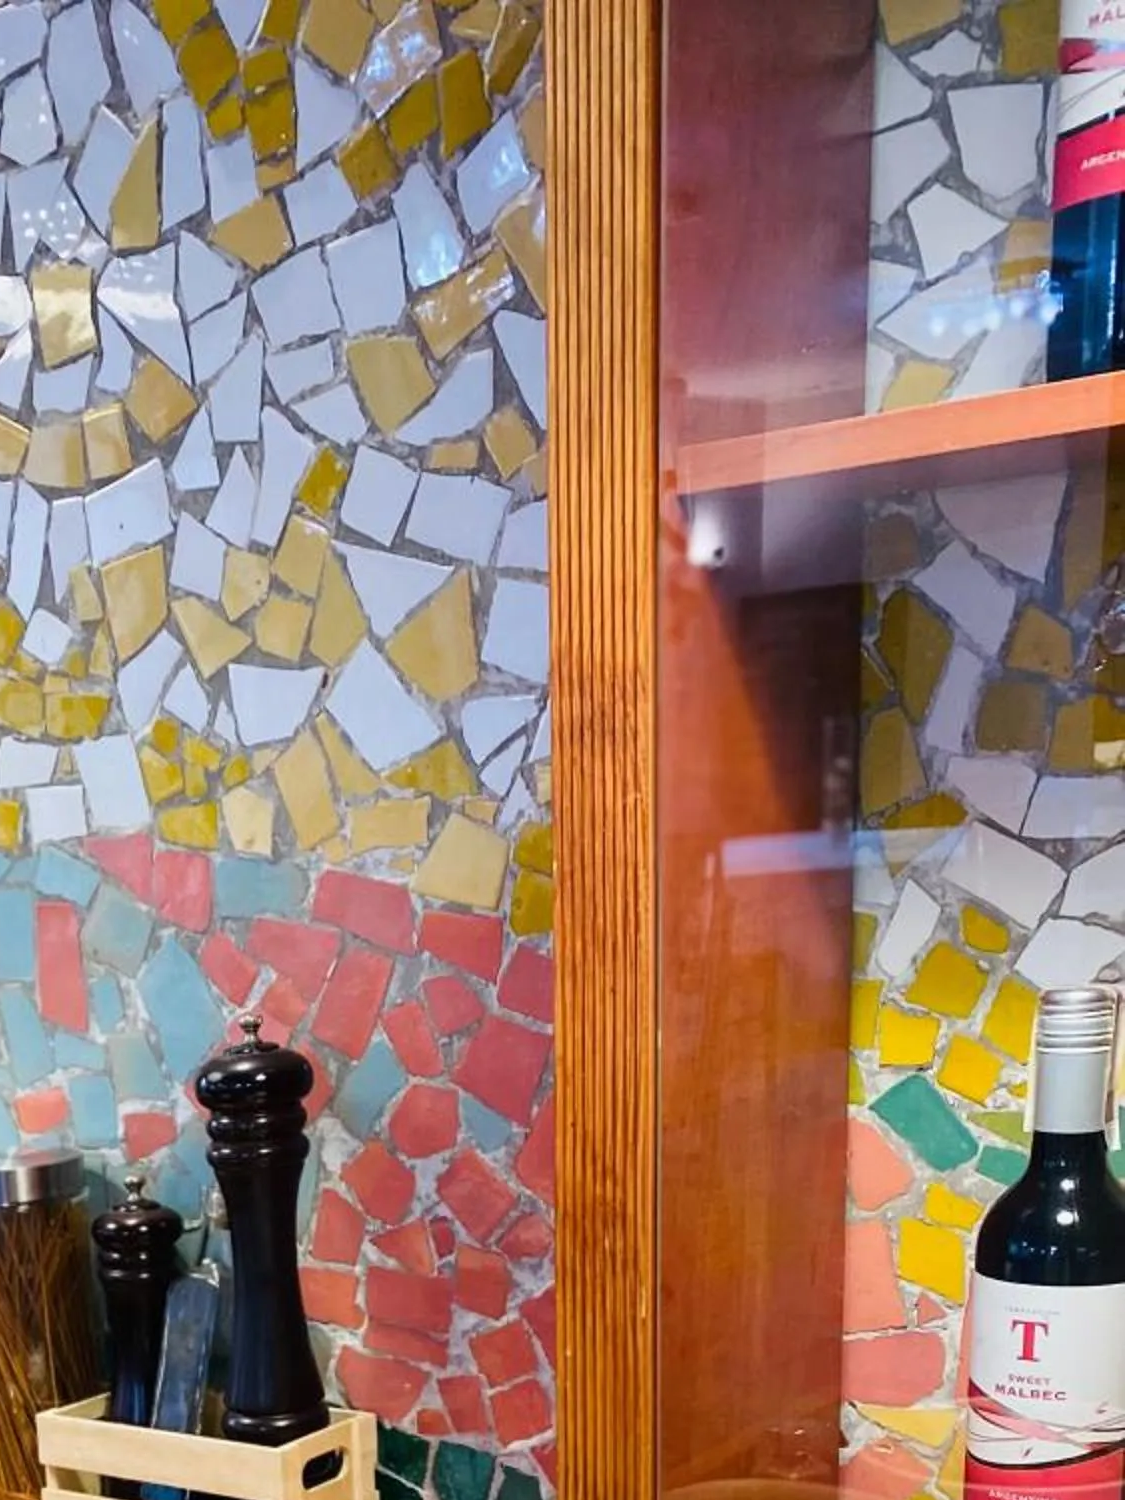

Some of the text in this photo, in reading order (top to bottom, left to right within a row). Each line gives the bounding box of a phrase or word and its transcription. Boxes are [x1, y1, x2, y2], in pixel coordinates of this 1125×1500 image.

[1011, 1319, 1049, 1363] T
[1008, 1373, 1052, 1386] SWEET
[994, 1383, 1067, 1401] MALBEC
